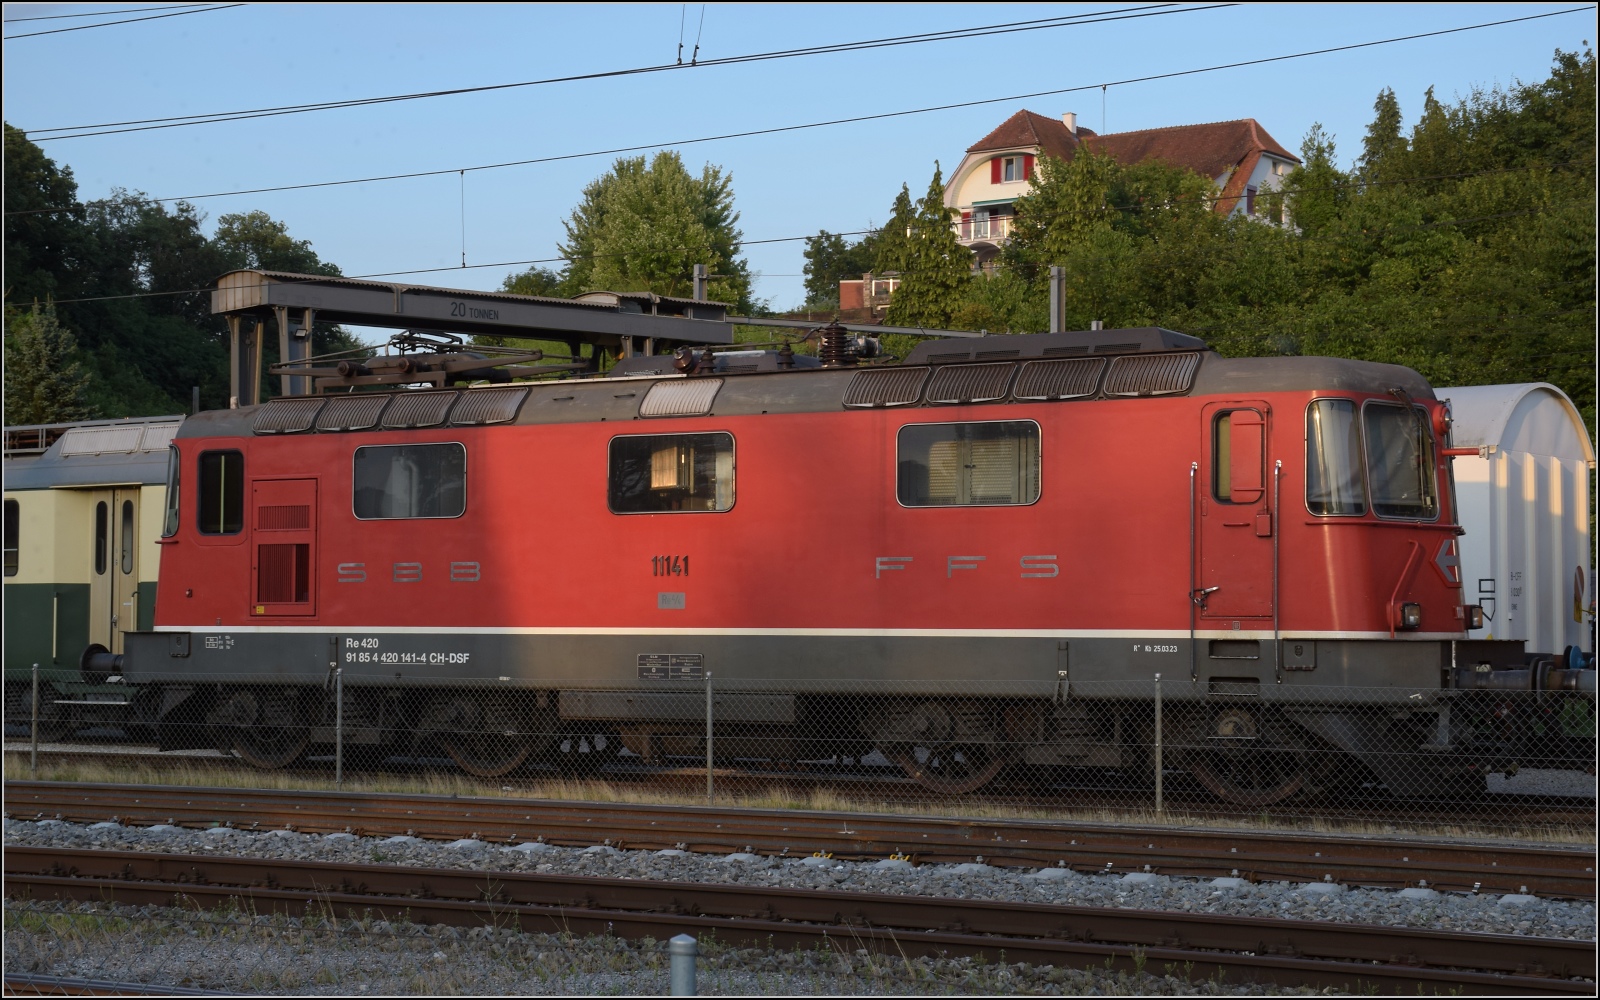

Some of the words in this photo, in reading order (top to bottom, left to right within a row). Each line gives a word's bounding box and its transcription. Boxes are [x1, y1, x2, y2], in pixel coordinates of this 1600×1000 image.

[450, 301, 466, 317] 20
[469, 307, 499, 320] TONNEN
[651, 554, 689, 577] 11141
[346, 638, 359, 648] Re
[361, 638, 379, 648] 420
[346, 652, 357, 662] 91
[358, 652, 371, 662] 85
[372, 652, 379, 662] 4
[380, 652, 399, 663] 420
[400, 652, 427, 663] 141-4
[429, 652, 470, 664] CH-DSF
